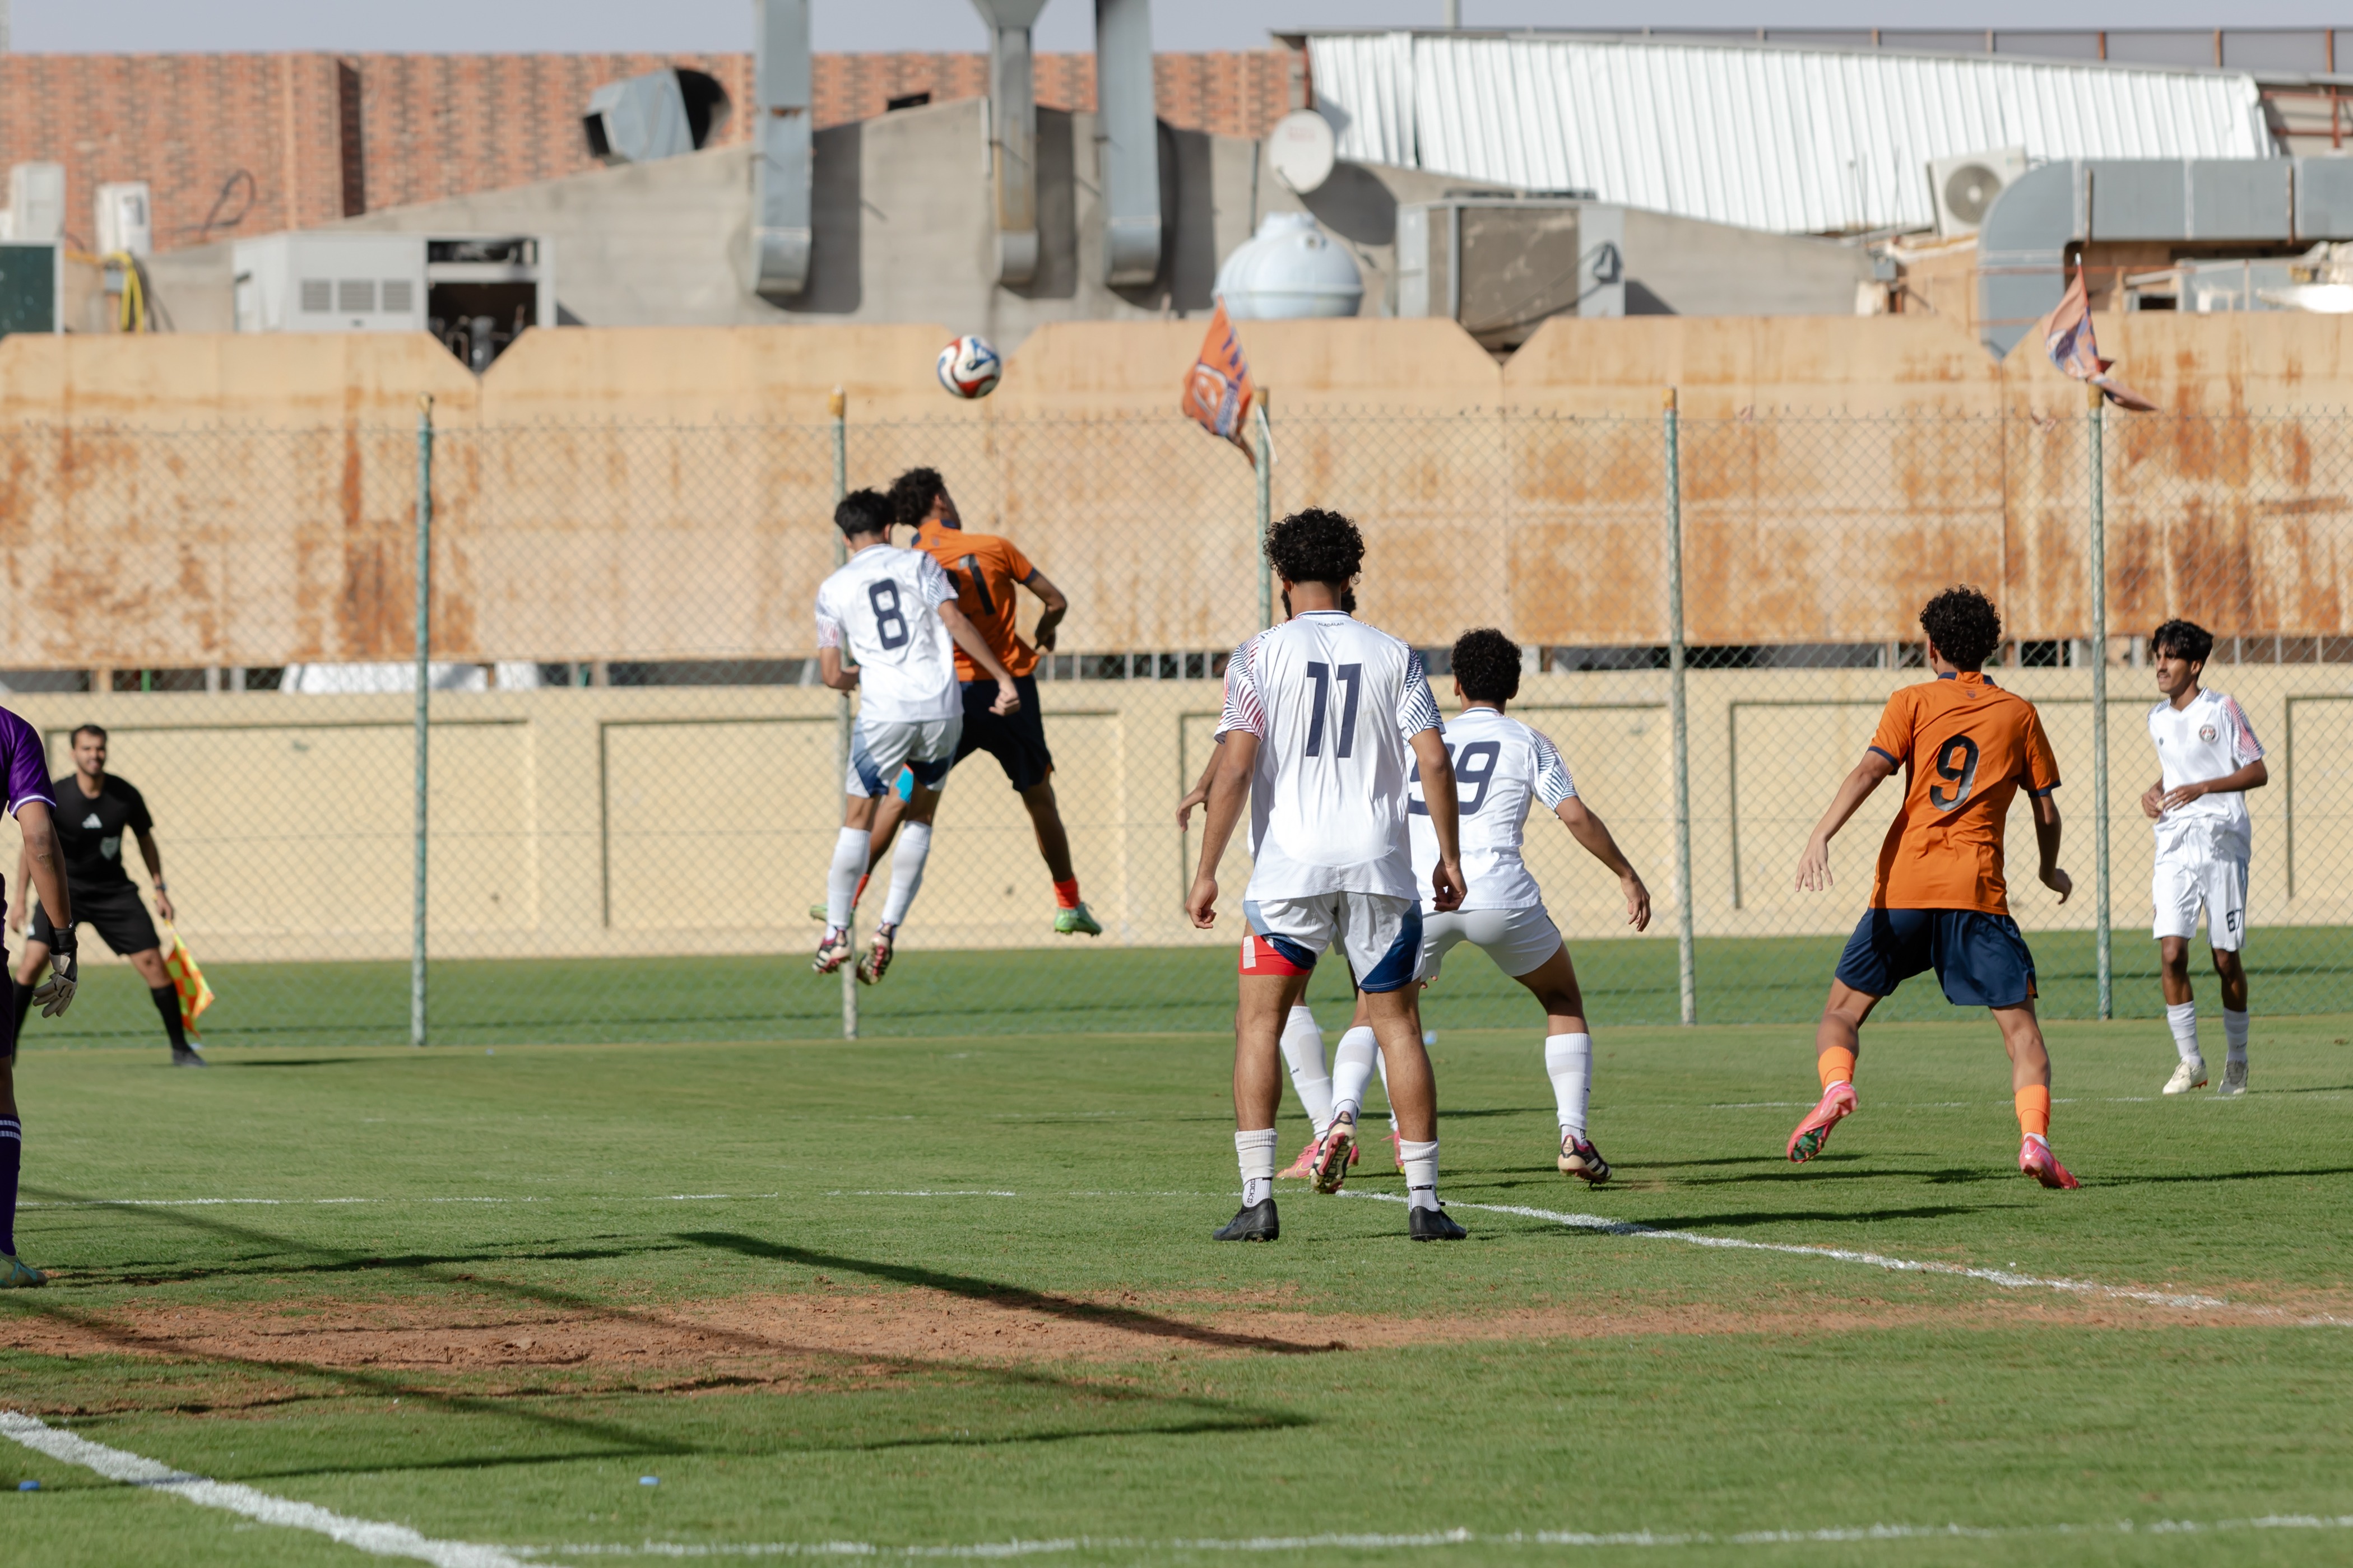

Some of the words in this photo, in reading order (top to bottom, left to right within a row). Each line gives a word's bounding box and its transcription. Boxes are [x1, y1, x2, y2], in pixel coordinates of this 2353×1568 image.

[869, 579, 908, 650] 8
[1306, 661, 1362, 759] 11
[1929, 734, 1979, 812] 9
